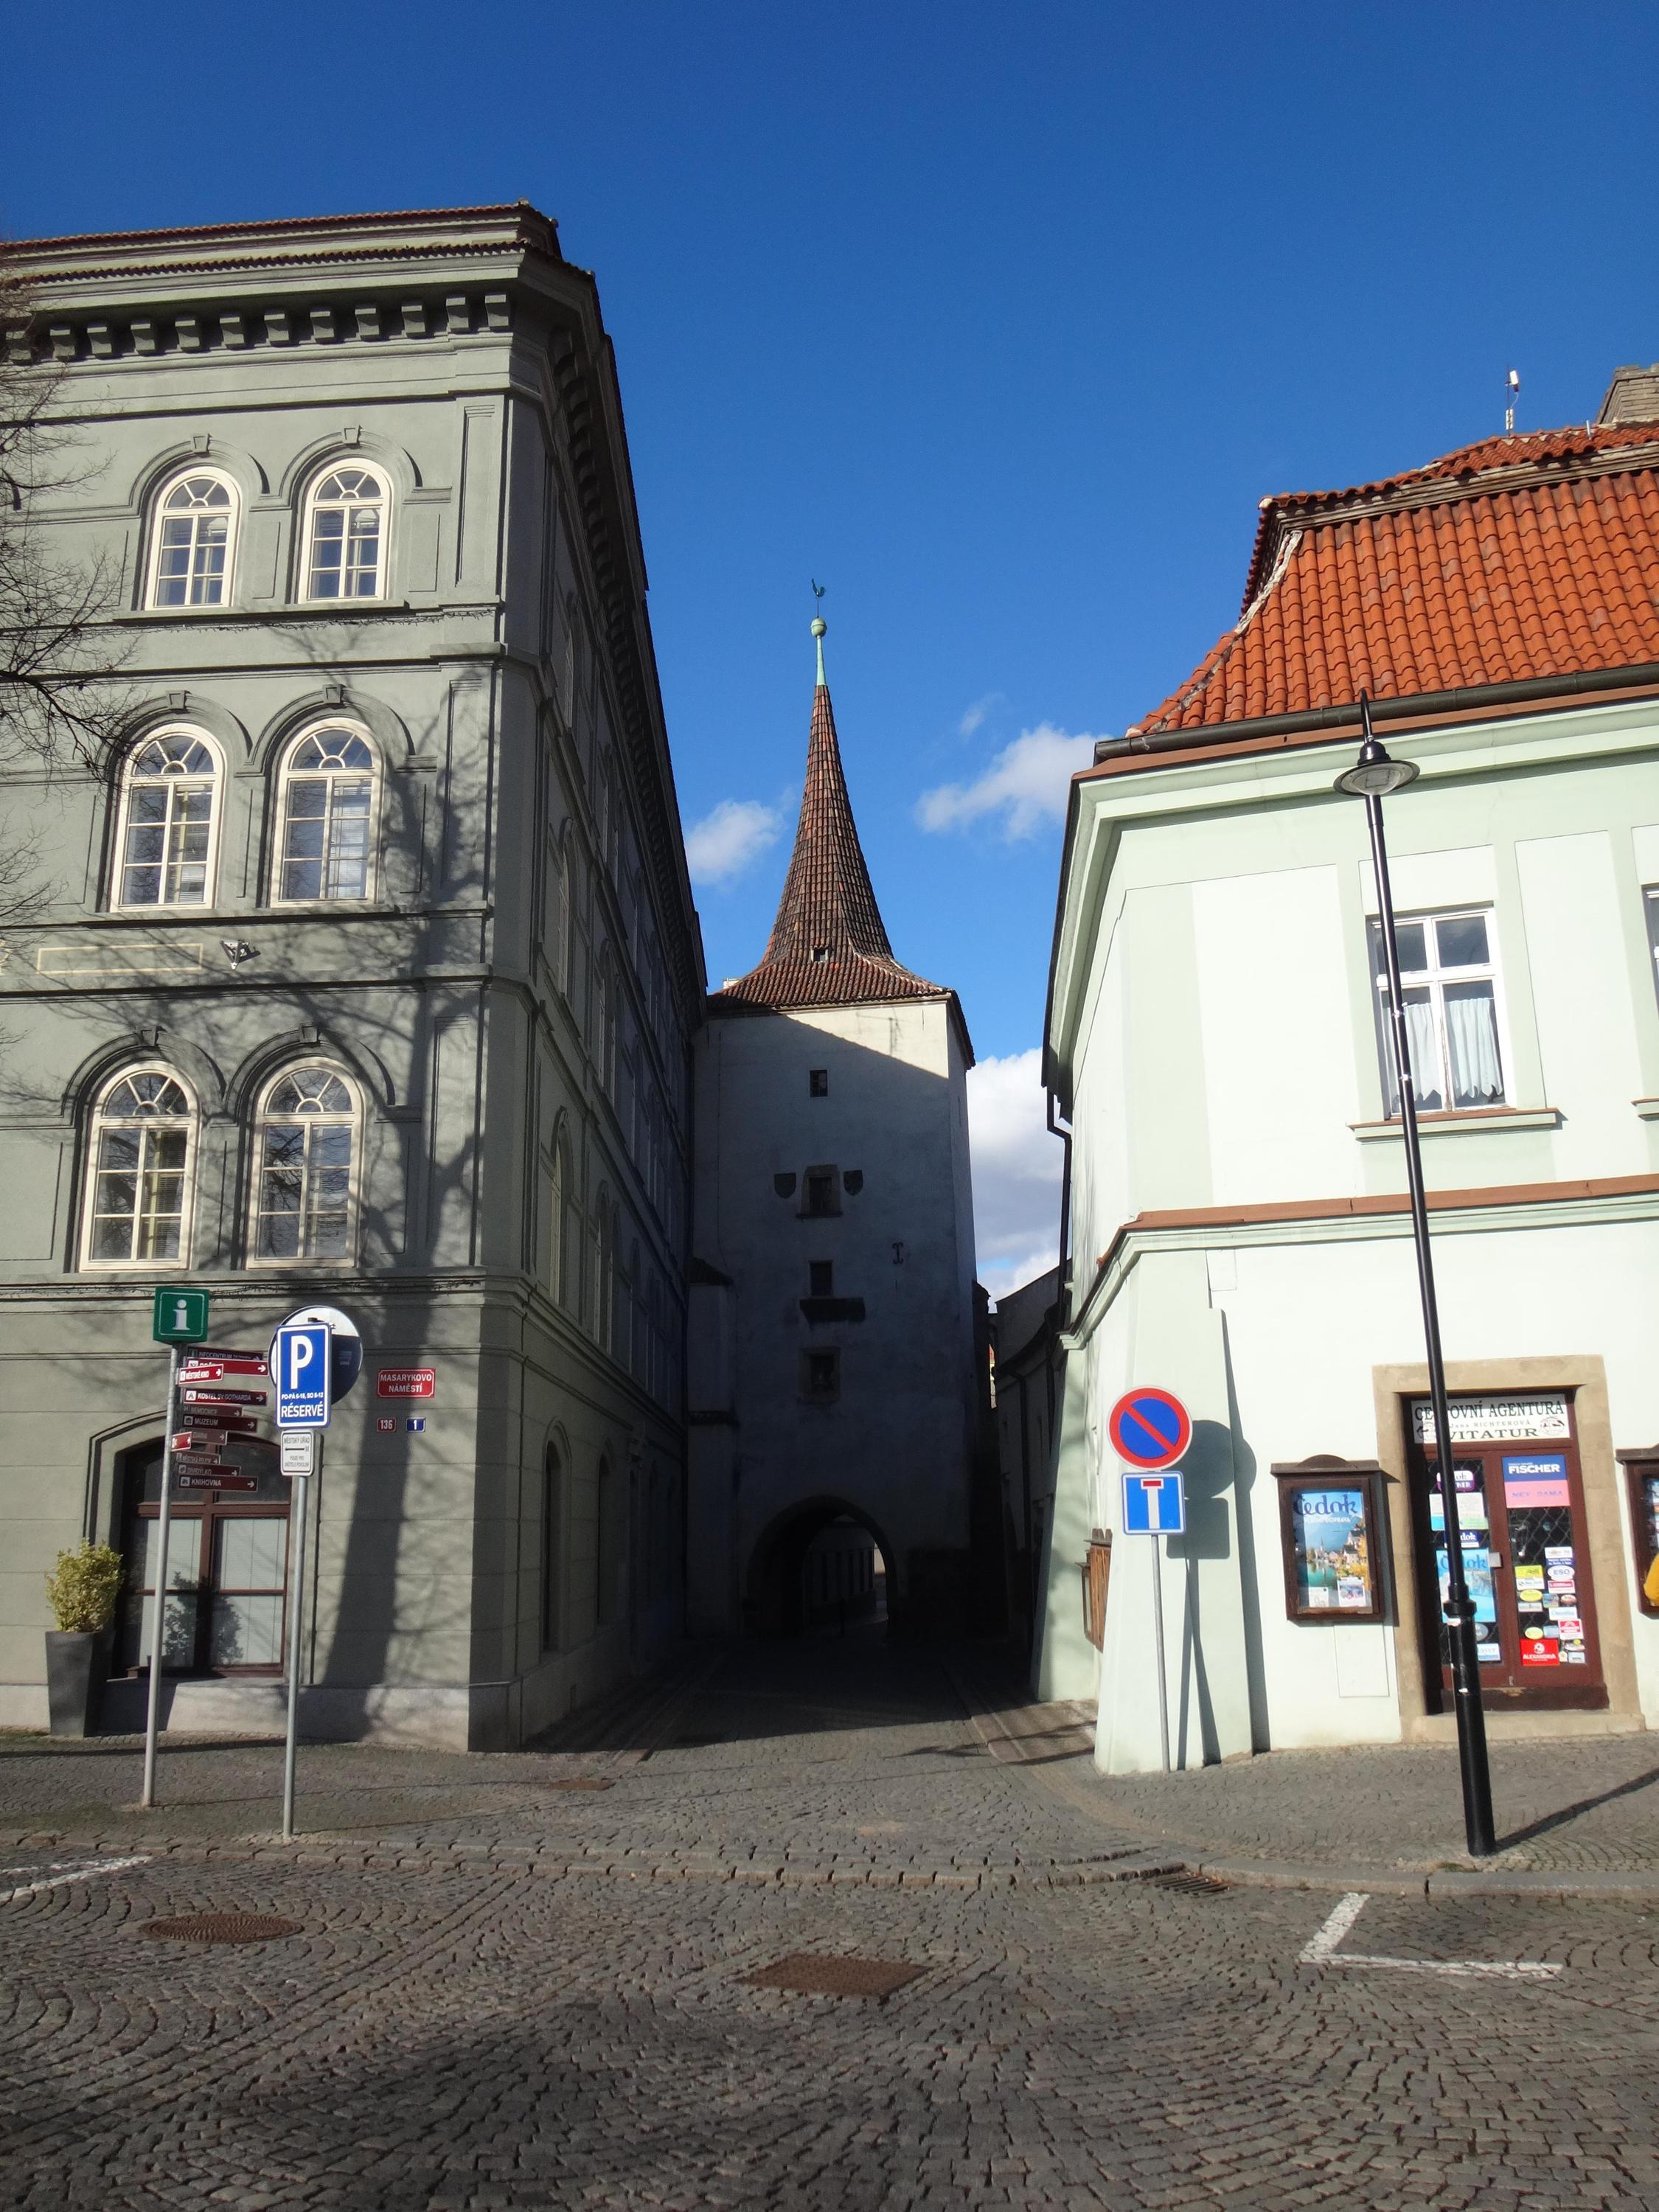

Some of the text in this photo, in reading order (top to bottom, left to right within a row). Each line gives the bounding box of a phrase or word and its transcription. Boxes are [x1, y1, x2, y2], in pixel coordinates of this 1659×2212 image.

[198, 1352, 232, 1360] INFOCENTRUM
[291, 1335, 313, 1389] P
[380, 1374, 432, 1382] MASARYKOVO
[389, 1382, 422, 1393] NÁMĚSTÍ
[281, 1401, 324, 1417] RÉSERVÉ
[1414, 1400, 1565, 1421] CEOVNÍ AGENTURA
[380, 1419, 393, 1430] 136
[413, 1419, 418, 1430] 1
[1473, 1419, 1531, 1427] RICHTEROVÁ
[1450, 1427, 1540, 1440] VITATUR
[1508, 1464, 1561, 1474] FISCHER
[1293, 1493, 1358, 1516] Čedok
[1460, 1531, 1477, 1541] dok
[1440, 1554, 1487, 1571] Čok
